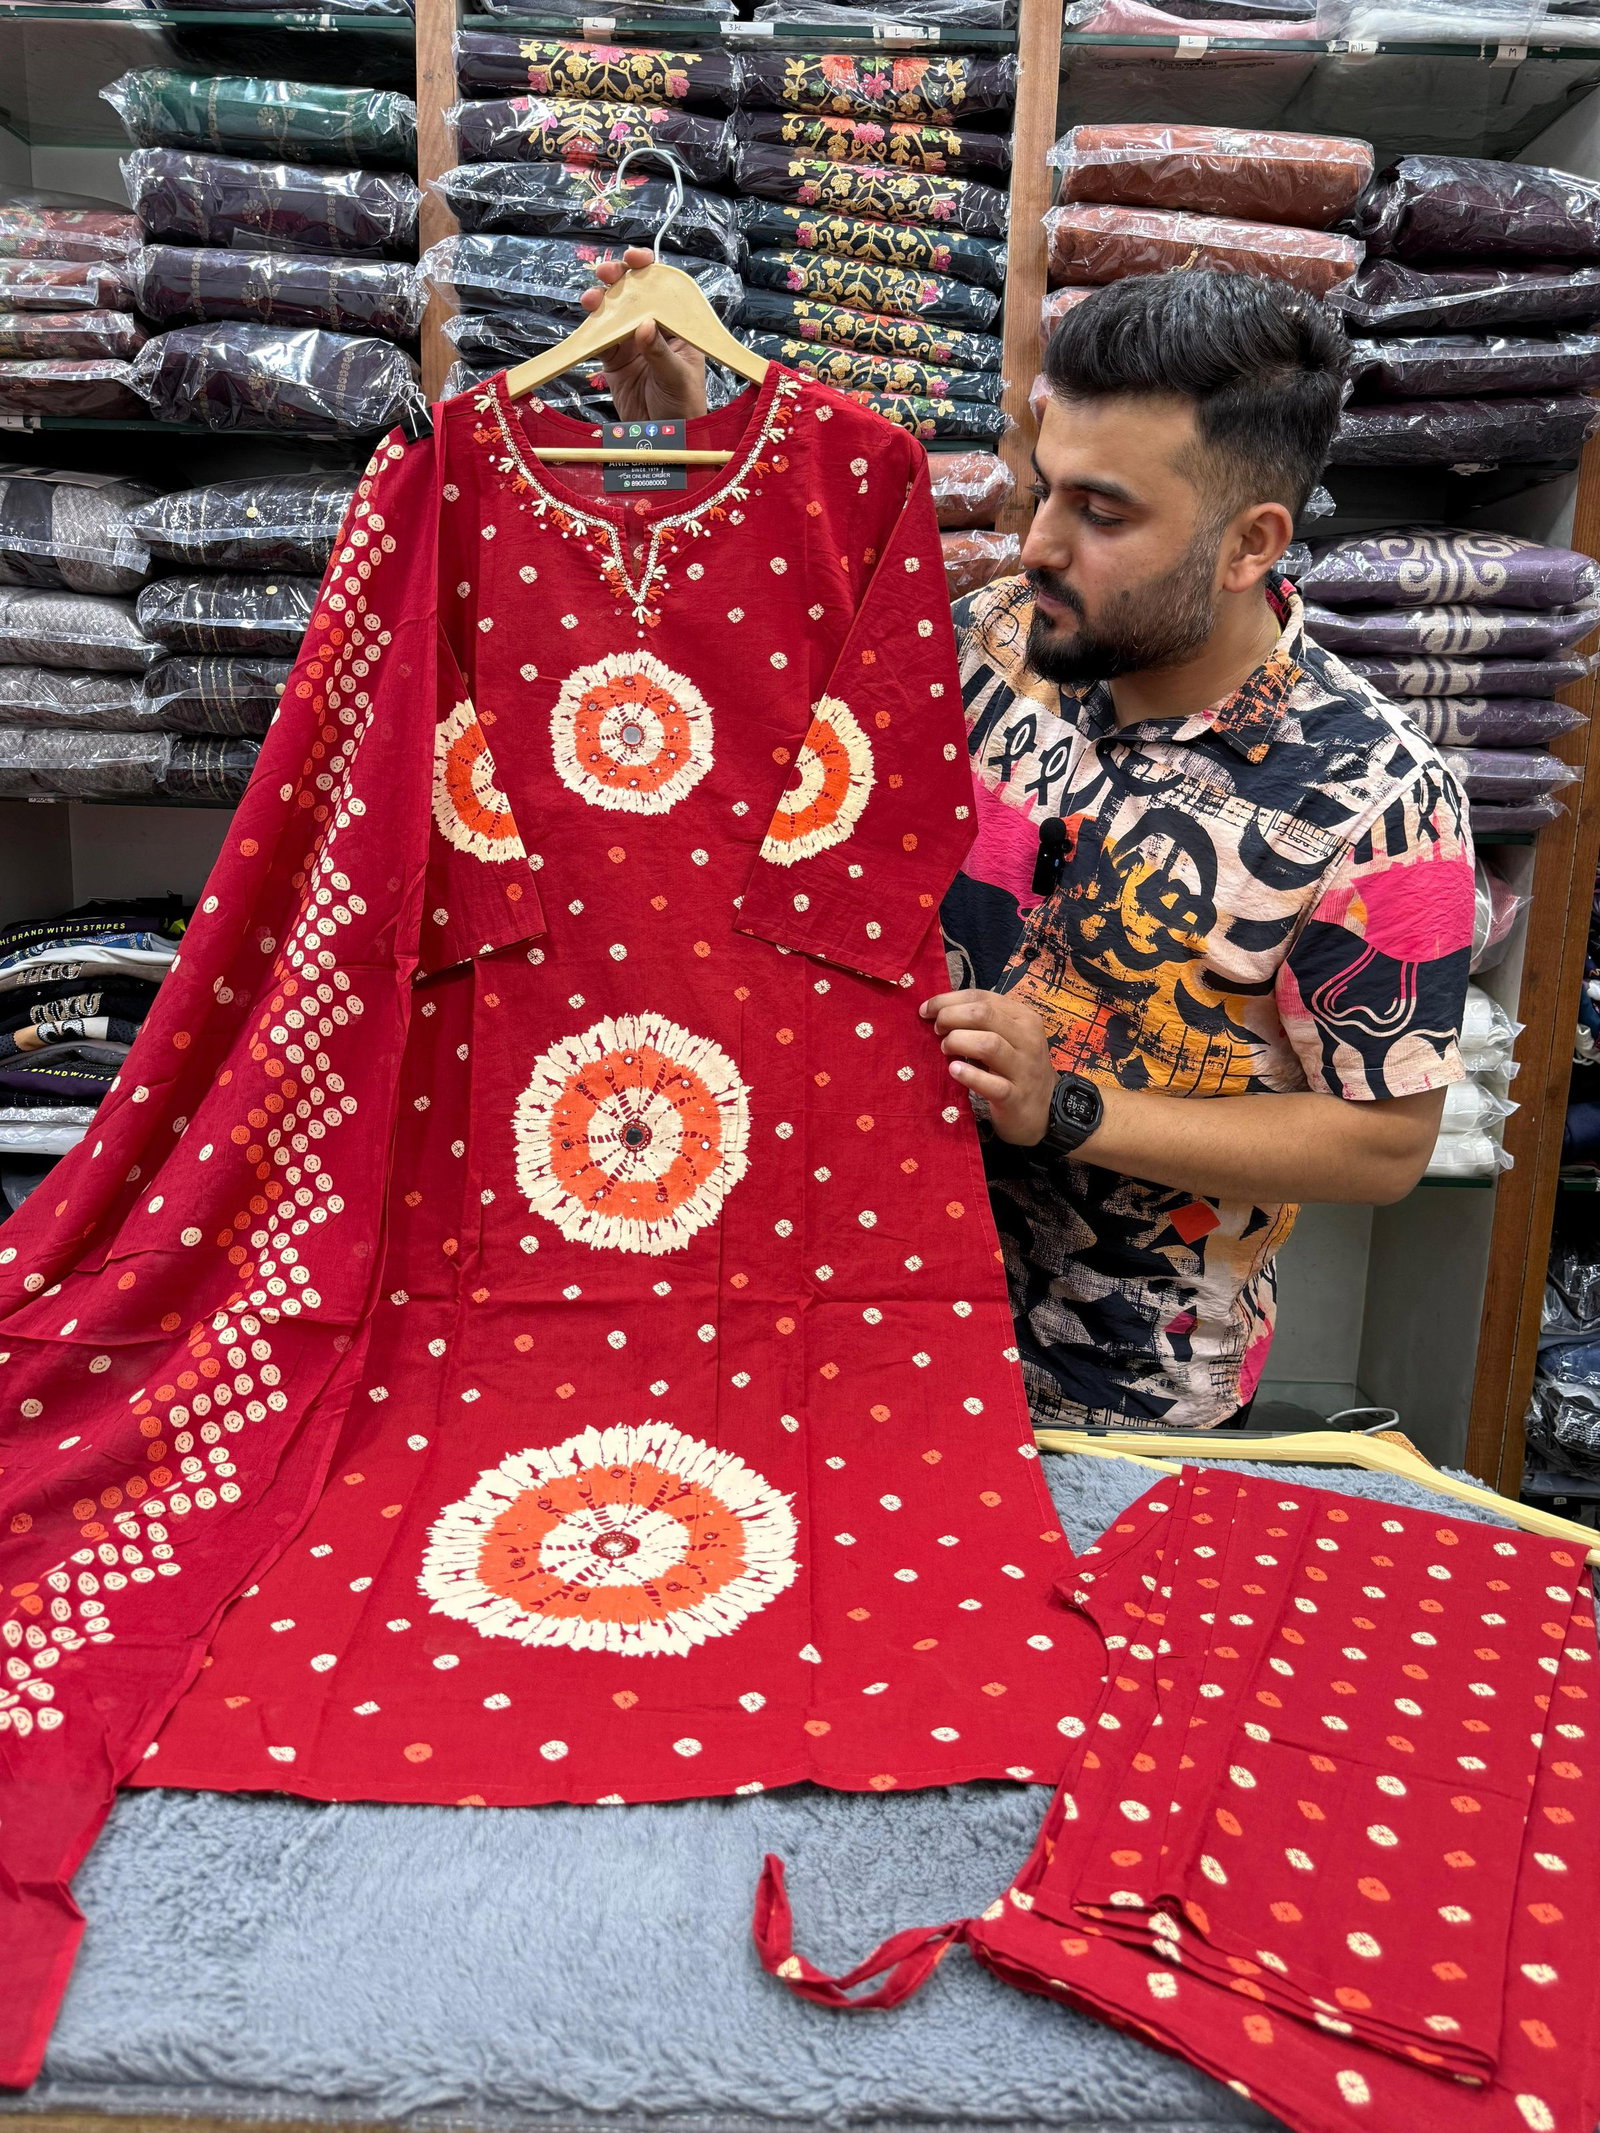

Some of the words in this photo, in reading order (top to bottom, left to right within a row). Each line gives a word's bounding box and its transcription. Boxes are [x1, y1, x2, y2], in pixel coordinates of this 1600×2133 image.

[1508, 48, 1517, 57] M
[11, 928, 44, 942] BRAND
[47, 925, 73, 934] WITH
[82, 922, 127, 932] STRIPES
[70, 1070, 97, 1079] WITH
